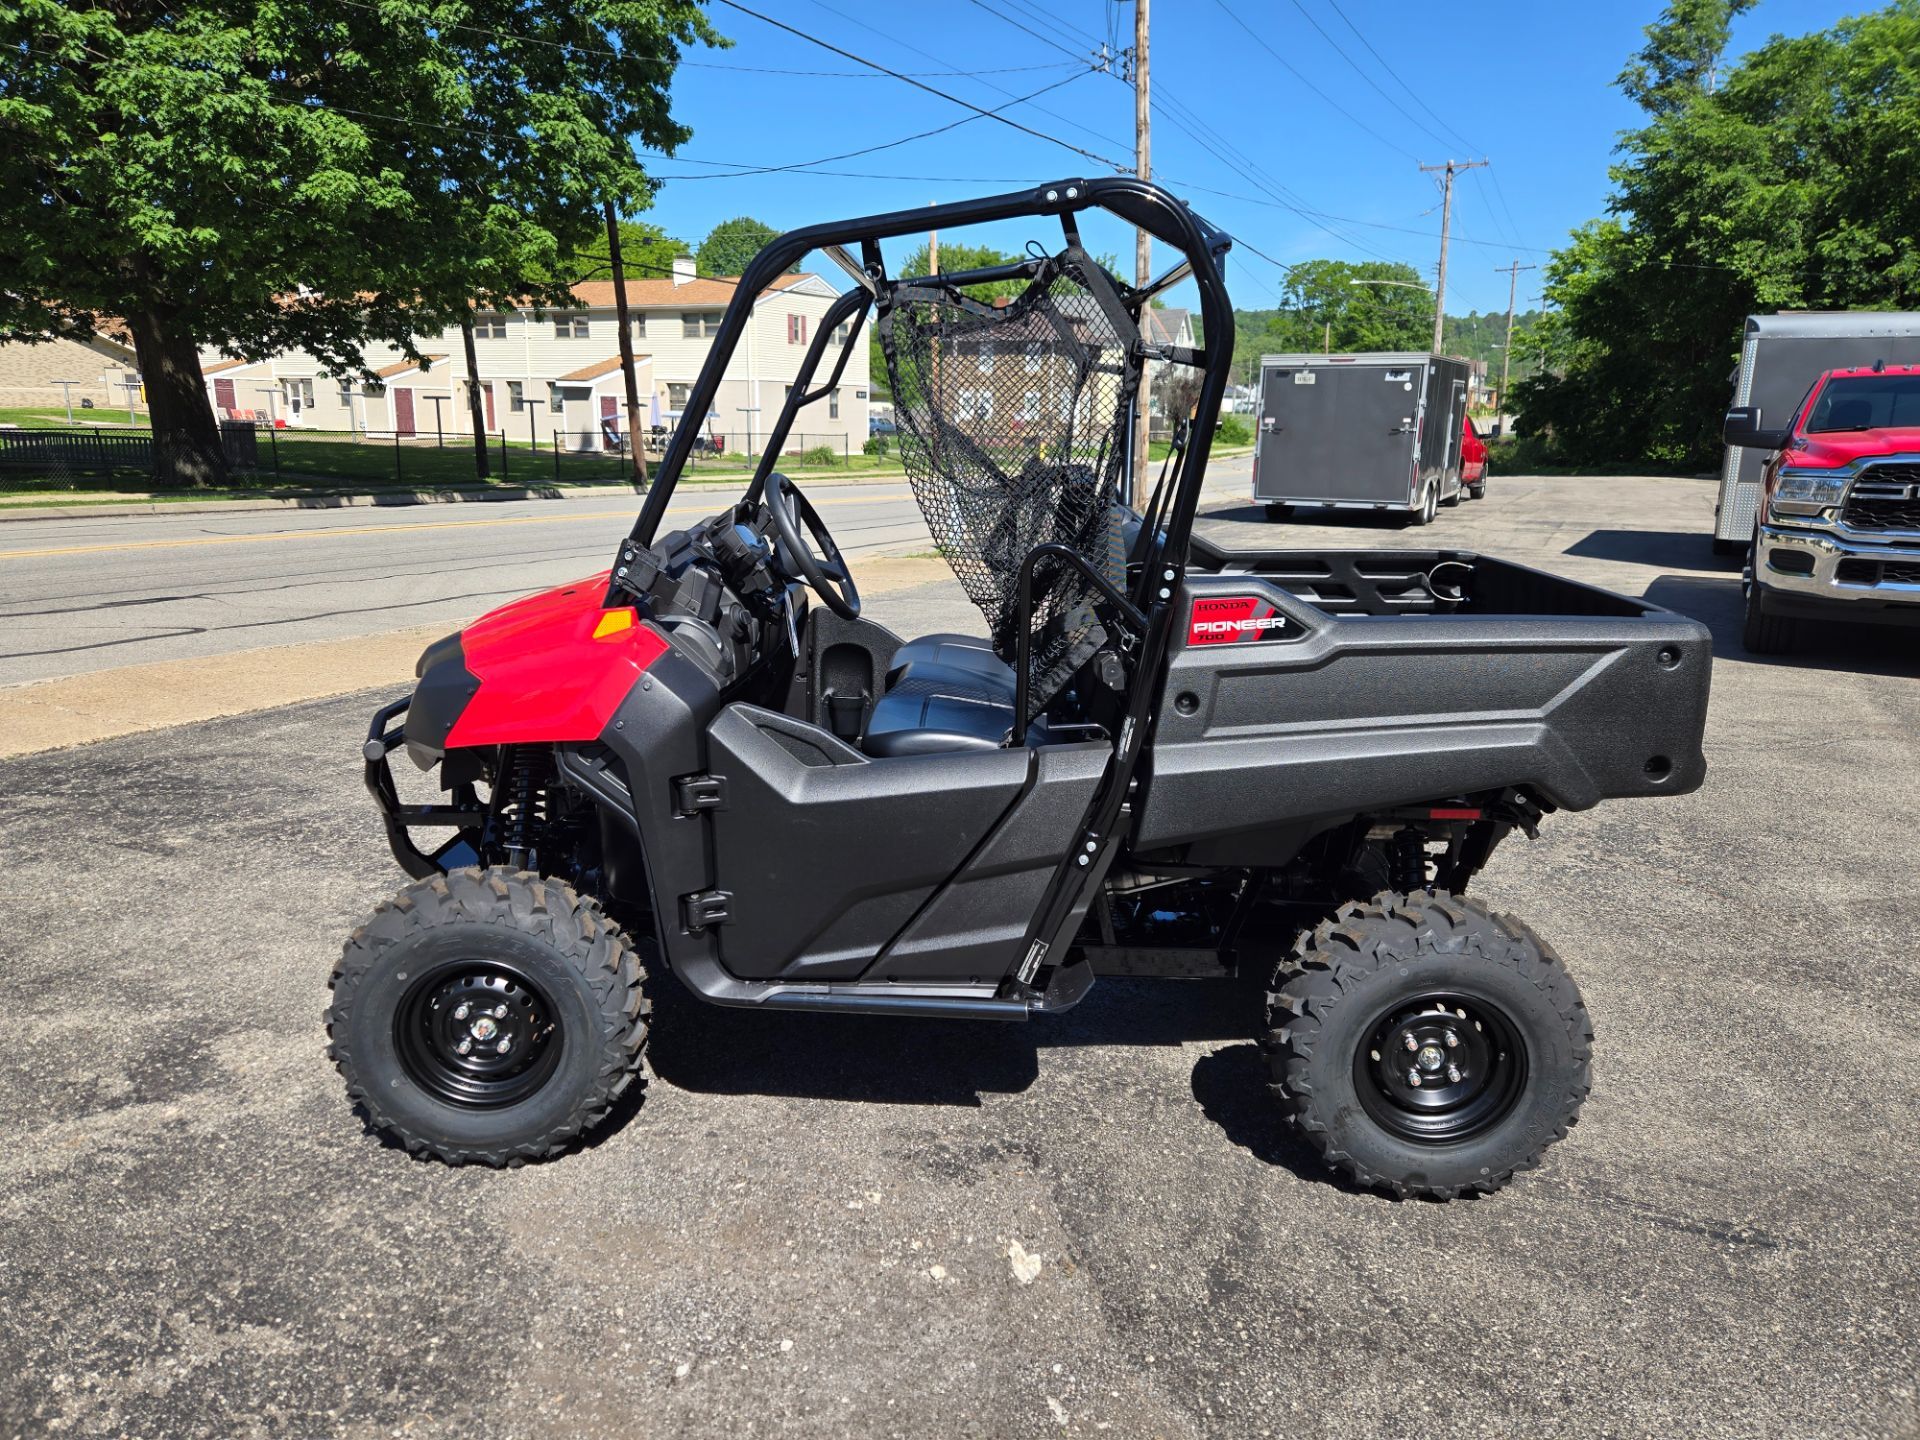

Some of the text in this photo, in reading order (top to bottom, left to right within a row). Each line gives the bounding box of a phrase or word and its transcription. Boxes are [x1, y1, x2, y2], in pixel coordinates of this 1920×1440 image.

[1198, 601, 1250, 611] HONDA
[1193, 617, 1286, 634] PIONEER
[1198, 633, 1225, 641] 700
